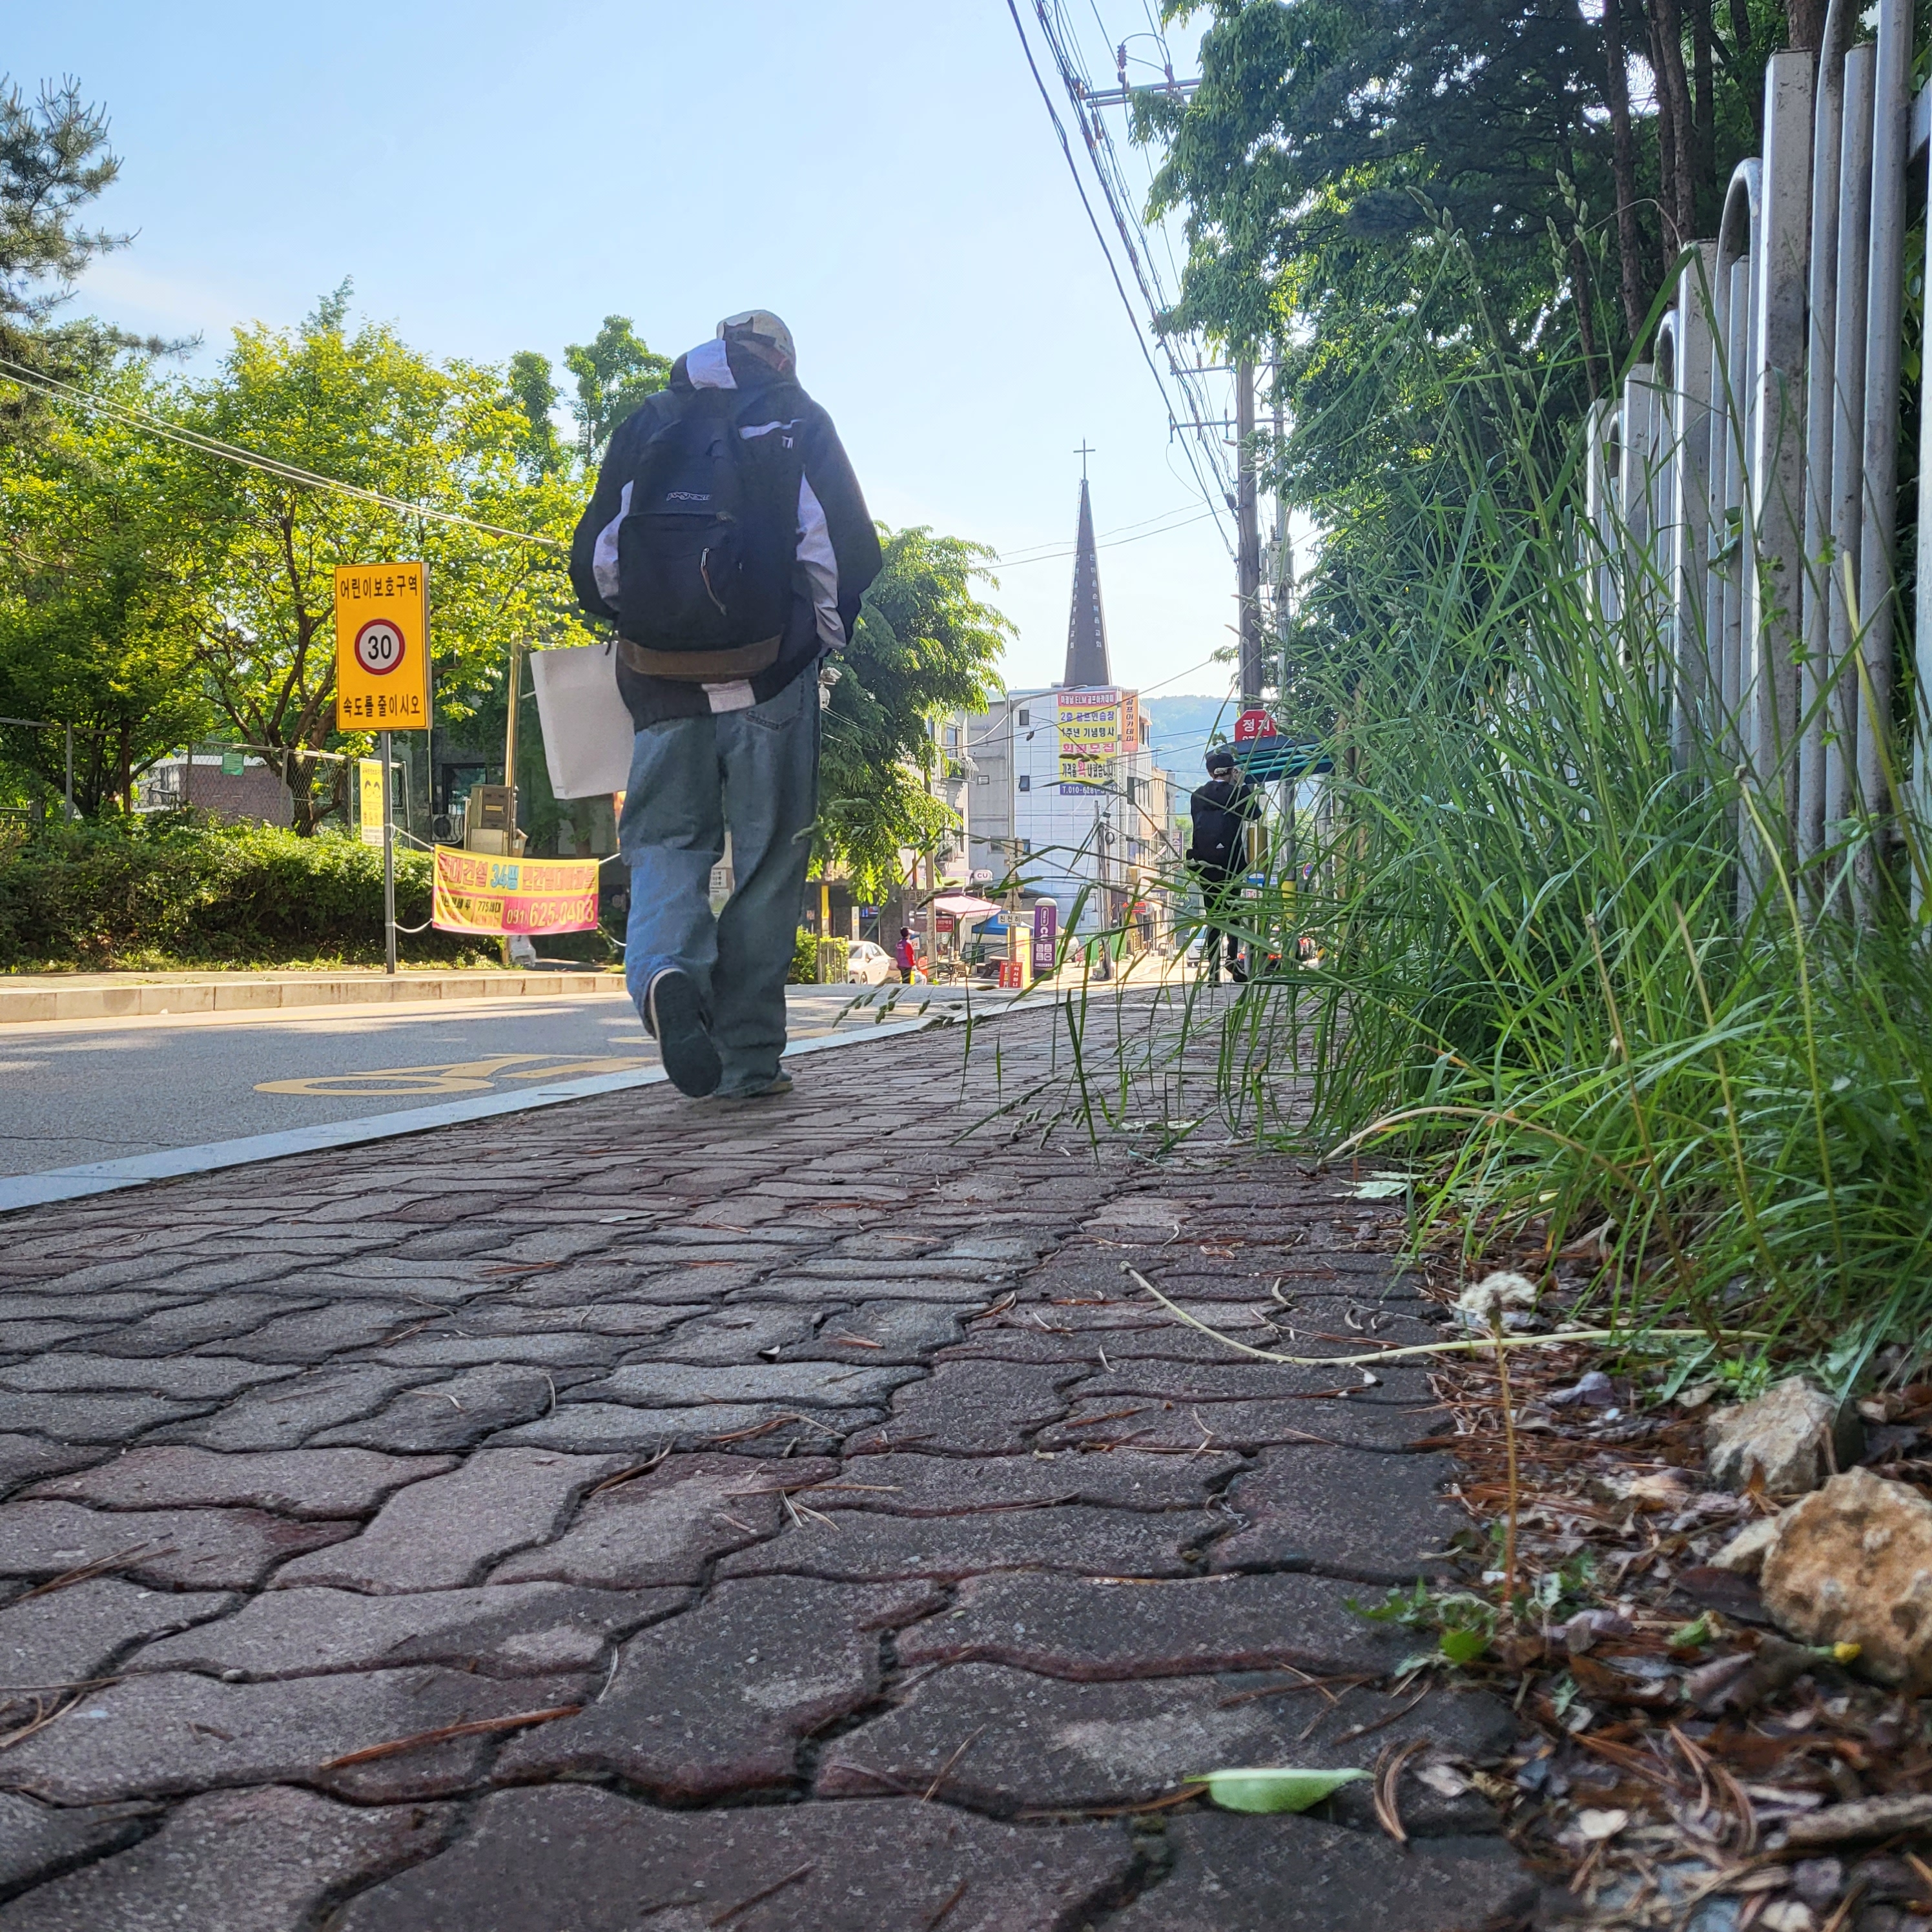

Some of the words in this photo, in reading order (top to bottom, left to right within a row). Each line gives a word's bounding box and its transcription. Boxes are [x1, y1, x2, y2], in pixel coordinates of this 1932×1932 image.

[340, 574, 418, 600] 어린이보호구역
[367, 635, 392, 660] 30
[343, 695, 374, 717] 속도를
[377, 694, 420, 717] 줄이시오
[1061, 712, 1073, 721] 2층
[1076, 711, 1115, 722] 골프연습장
[1242, 718, 1270, 732] 정지
[1084, 726, 1115, 737] 기념행사
[1063, 743, 1115, 754] 회원모집
[490, 863, 519, 890] 34평
